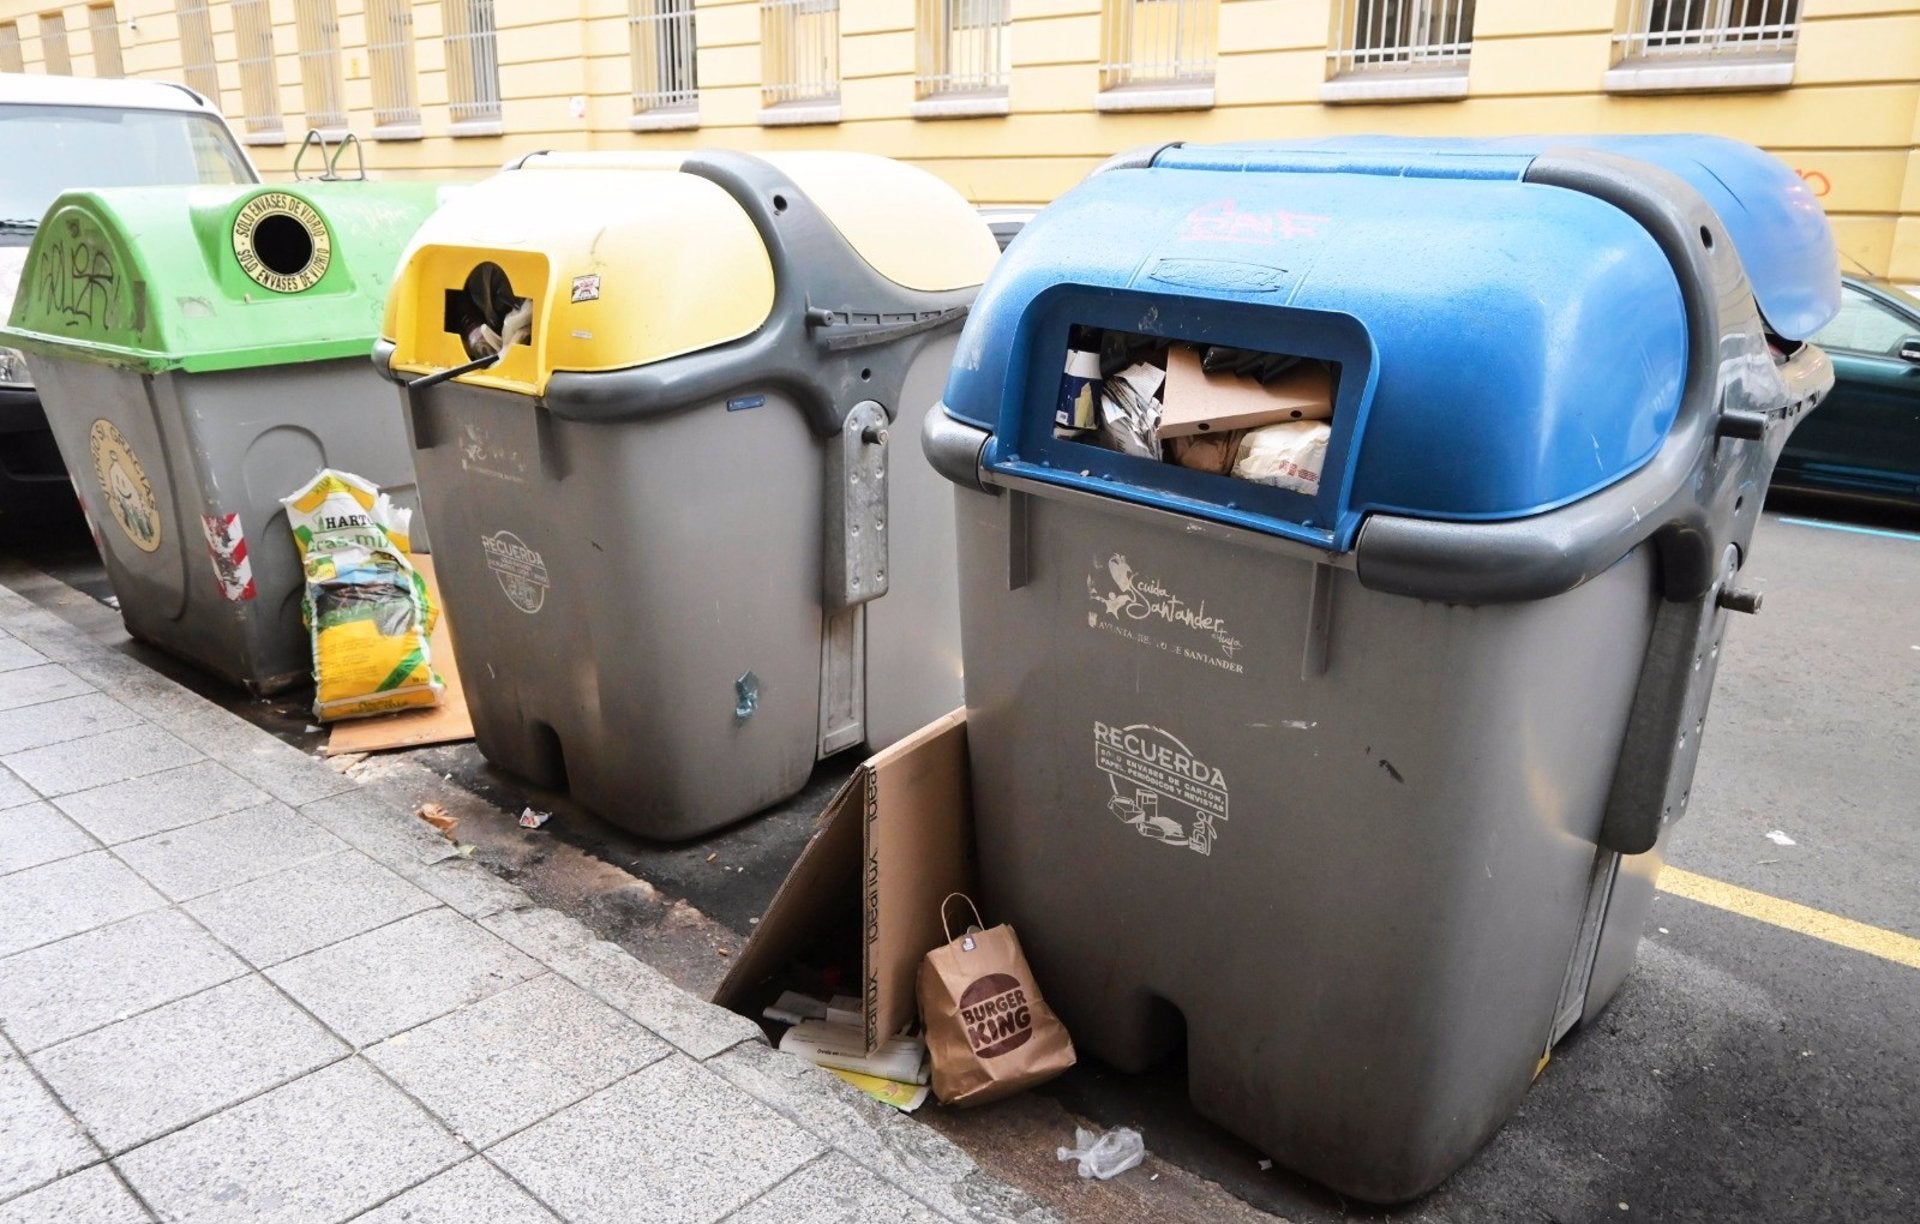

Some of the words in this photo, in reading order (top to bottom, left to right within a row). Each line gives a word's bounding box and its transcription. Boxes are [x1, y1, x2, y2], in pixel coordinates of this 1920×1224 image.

[236, 212, 255, 238] SOLO
[247, 194, 287, 217] ENVASES
[288, 198, 302, 214] DE
[301, 205, 325, 237] VIDRIO
[238, 249, 259, 273] SOLO
[256, 269, 298, 290] ENVASES
[299, 274, 314, 288] DE
[308, 248, 329, 278] VIDRIO
[481, 534, 545, 567] RECUERDA
[1126, 572, 1225, 632] Santander
[1137, 579, 1171, 598] cuida
[1183, 649, 1243, 674] SANTANDER
[1093, 721, 1228, 791] RECUERDA
[1126, 760, 1164, 779] ENVASES
[1168, 776, 1181, 787] DE
[1183, 792, 1224, 812] REVISTAS
[961, 989, 1027, 1026] BURGER
[968, 1005, 1031, 1049] KING
